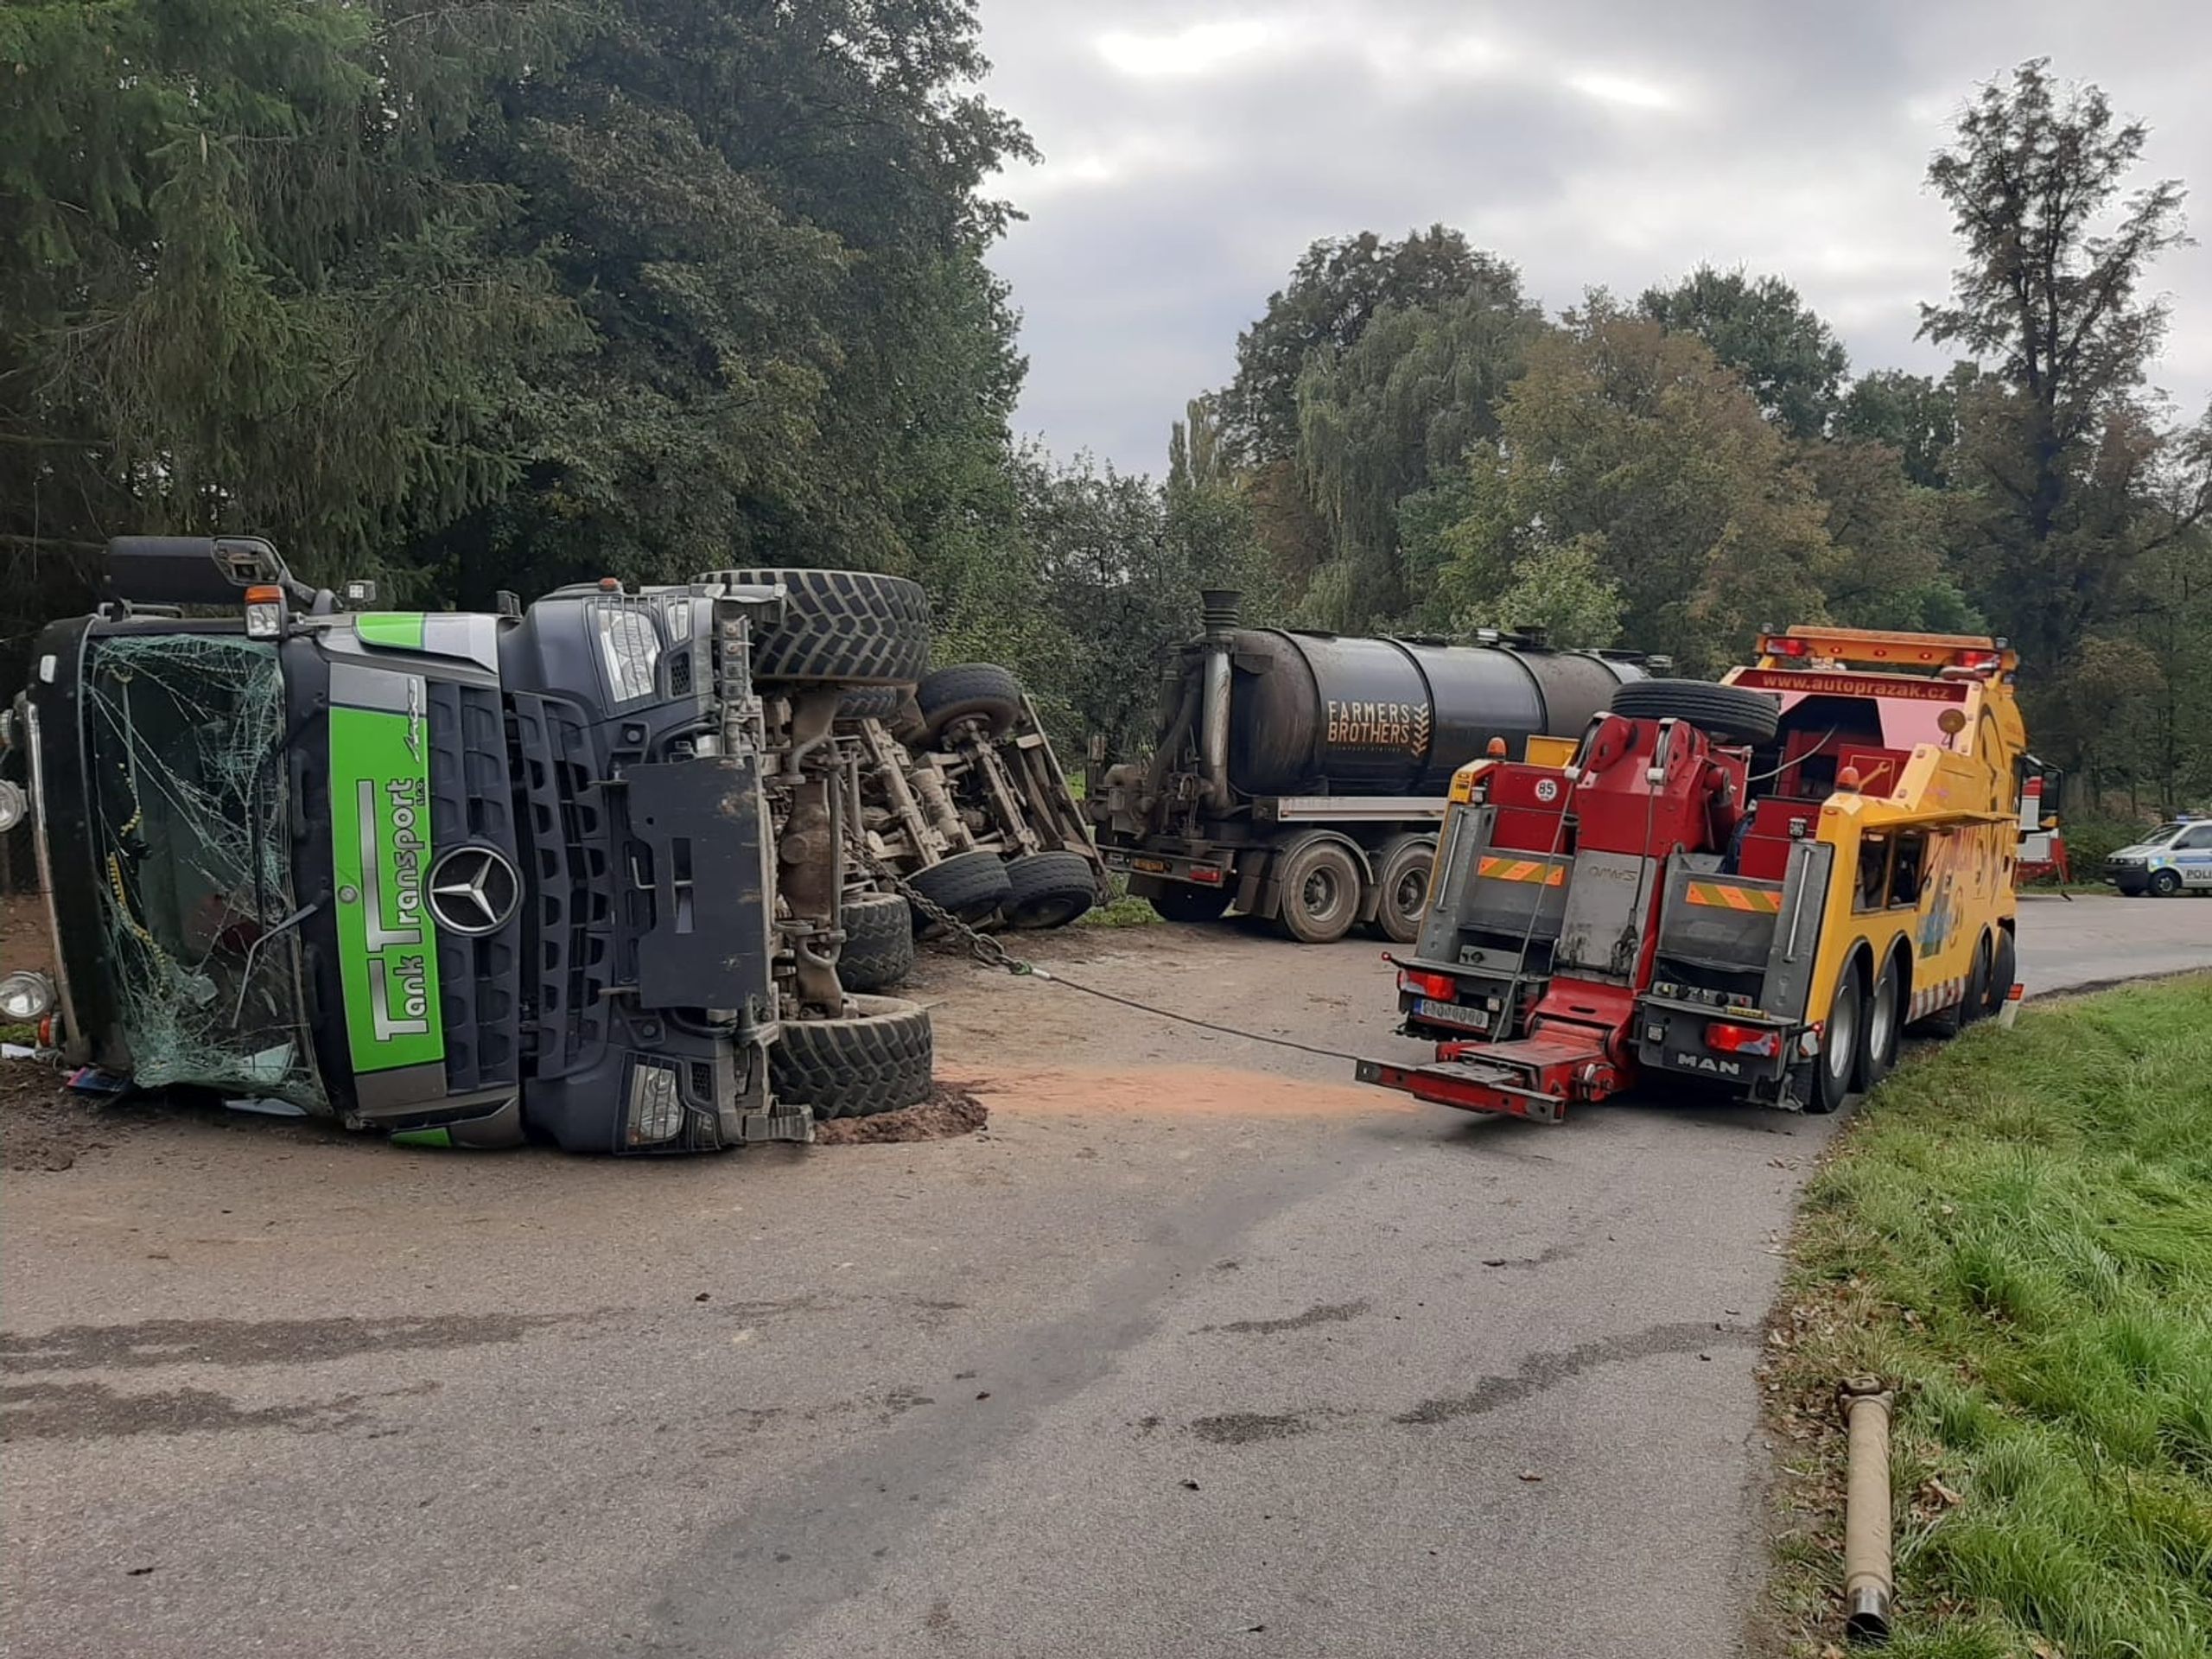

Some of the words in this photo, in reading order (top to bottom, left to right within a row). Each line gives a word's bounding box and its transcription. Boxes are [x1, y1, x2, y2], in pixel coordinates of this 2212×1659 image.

[1762, 674, 1949, 700] www.autoprazak.cz
[1327, 700, 1410, 724] FARMERS
[1327, 721, 1410, 744] BROTHERS
[1538, 782, 1554, 795] 85
[356, 779, 426, 954] Transport
[367, 955, 429, 1042] Tank
[1677, 1052, 1740, 1076] MAN
